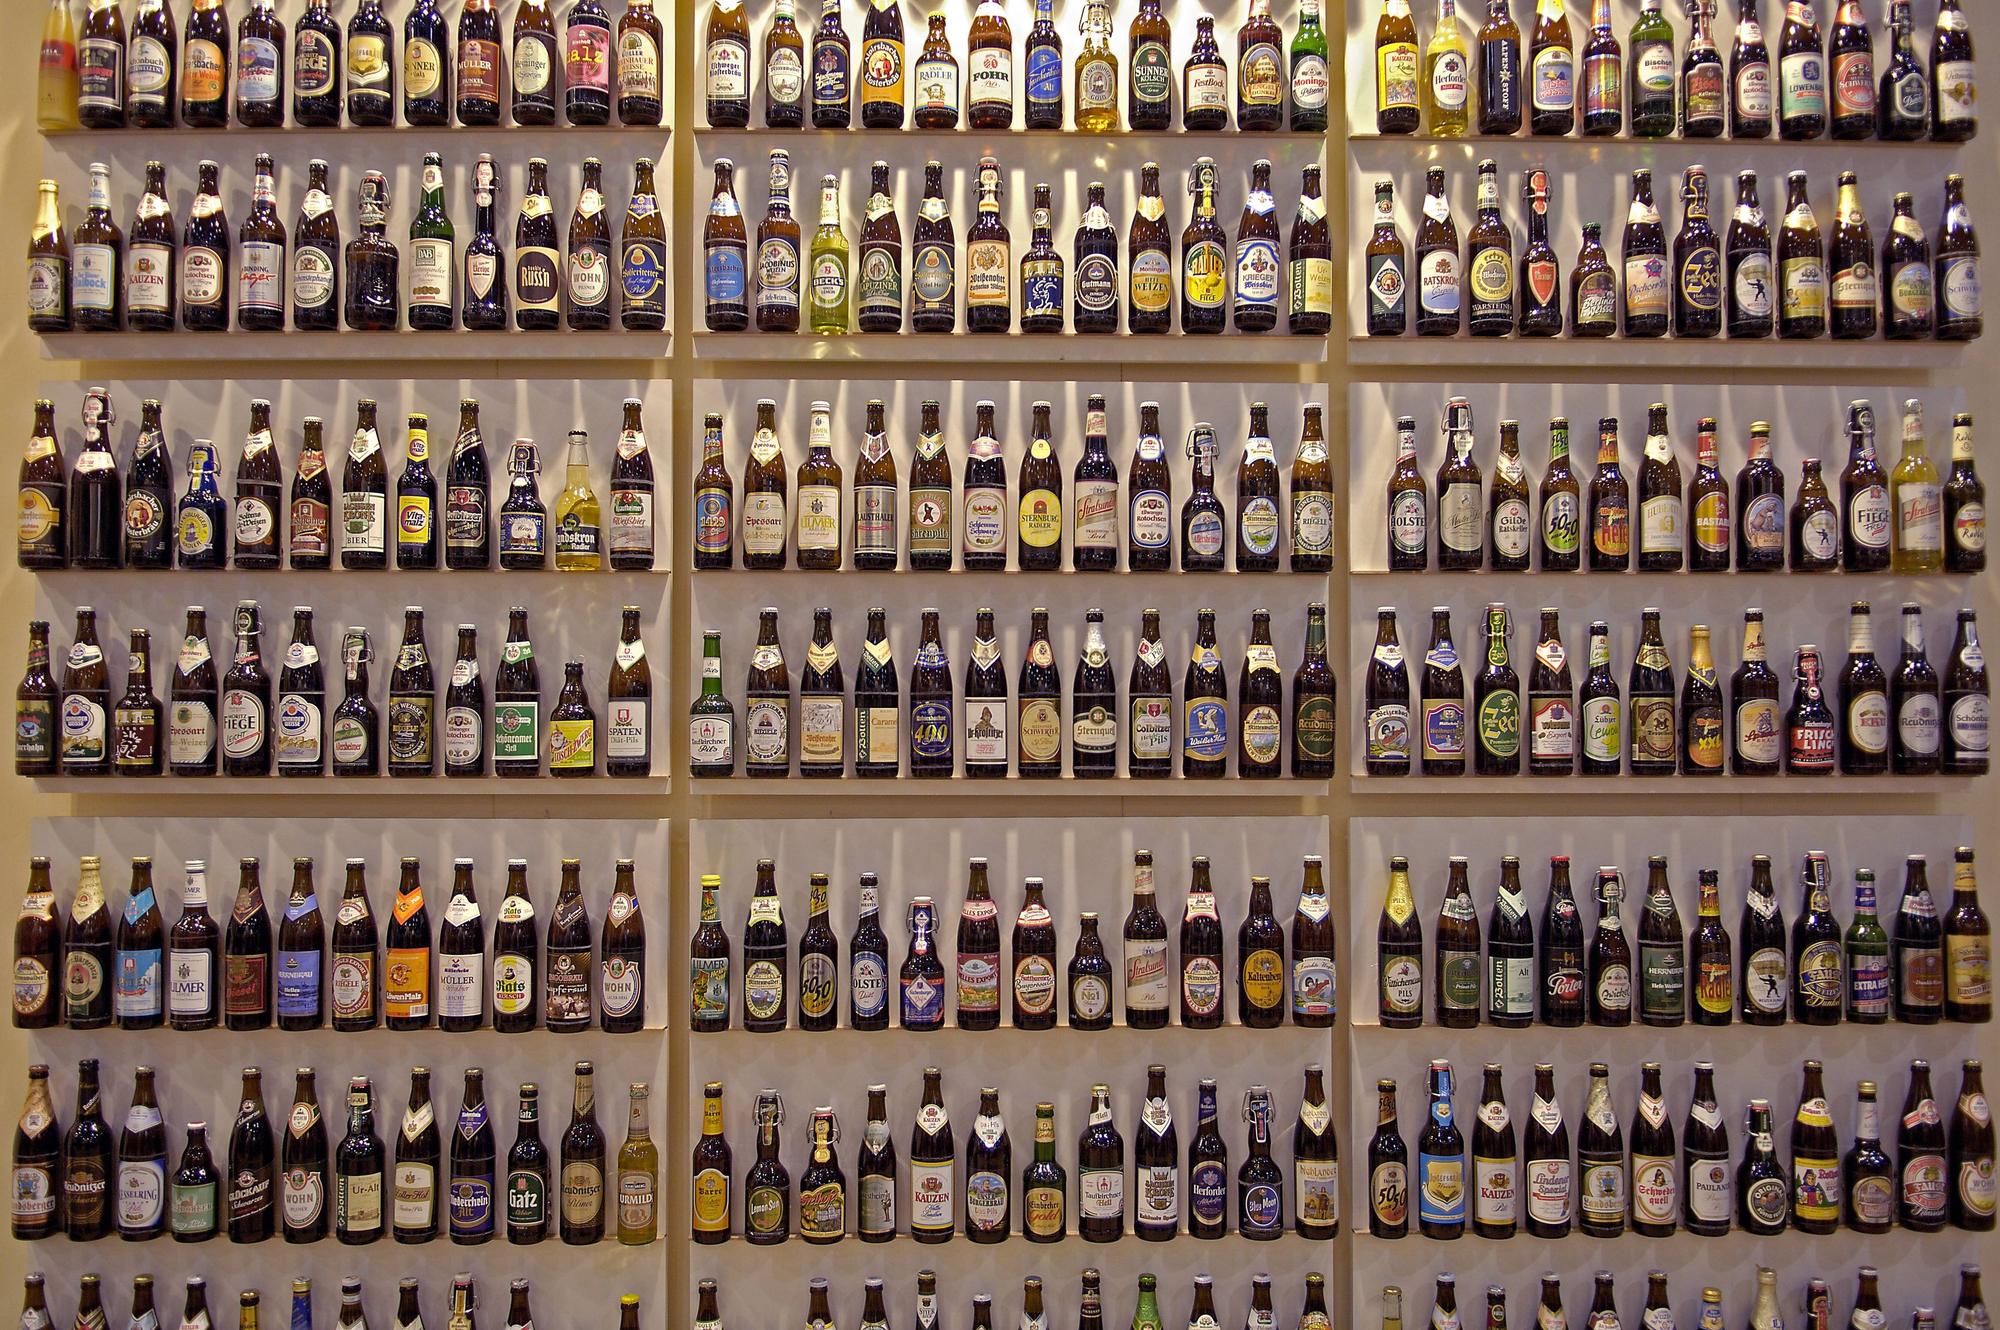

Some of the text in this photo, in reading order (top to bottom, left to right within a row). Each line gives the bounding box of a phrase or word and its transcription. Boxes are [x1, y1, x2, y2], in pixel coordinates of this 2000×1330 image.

[864, 42, 900, 64] Alpirsbacher
[865, 73, 900, 87] Klosterbräu
[920, 71, 952, 80] RADLER
[973, 71, 1008, 81] FOHR
[1194, 79, 1225, 88] FestBock
[418, 248, 432, 260] DAB
[572, 273, 600, 283] WOHN
[1243, 273, 1274, 282] KRIEGER
[1583, 298, 1615, 308] Berliner
[406, 511, 424, 521] Vita-
[1021, 515, 1058, 524] STERNBURG
[1500, 517, 1526, 525] Gilde
[405, 518, 424, 528] malz
[745, 517, 781, 527] Spessart
[801, 517, 836, 528] ULMER
[1551, 514, 1577, 535] 50 50
[400, 703, 421, 716] WEISSE
[608, 727, 641, 736] SPATEN
[915, 724, 946, 743] 400
[1546, 732, 1568, 740] Export
[227, 732, 245, 745] LEICHT
[611, 736, 638, 744] Diät-Pils
[1150, 734, 1168, 746] Pils
[698, 745, 718, 753] Pils
[504, 906, 521, 915] Rats
[693, 960, 724, 969] ULMER
[1519, 968, 1529, 976] Alt
[1495, 960, 1503, 999] Bolten
[1549, 972, 1583, 994] Porter
[496, 981, 525, 992] Rats
[604, 982, 631, 992] WOHN
[803, 976, 830, 1001] 50 50
[1854, 981, 1873, 989] EXTRA
[704, 1109, 722, 1117] Barre
[1095, 1112, 1108, 1120] Hell
[352, 1183, 379, 1195] Ur-Alt
[286, 1193, 313, 1205] WOHN
[509, 1190, 538, 1208] Gatz
[619, 1194, 652, 1205] URMILD
[915, 1192, 950, 1202] KAUZEN
[1085, 1191, 1121, 1200] Taufkirchner
[1380, 1184, 1395, 1205] 50
[1098, 1198, 1112, 1206] Hell
[1249, 1197, 1276, 1211] Blue Moon
[1648, 1195, 1669, 1205] quell
[457, 1206, 474, 1217] Alt
[751, 1200, 780, 1214] Lemon Sun
[1028, 1210, 1060, 1222] Gold
